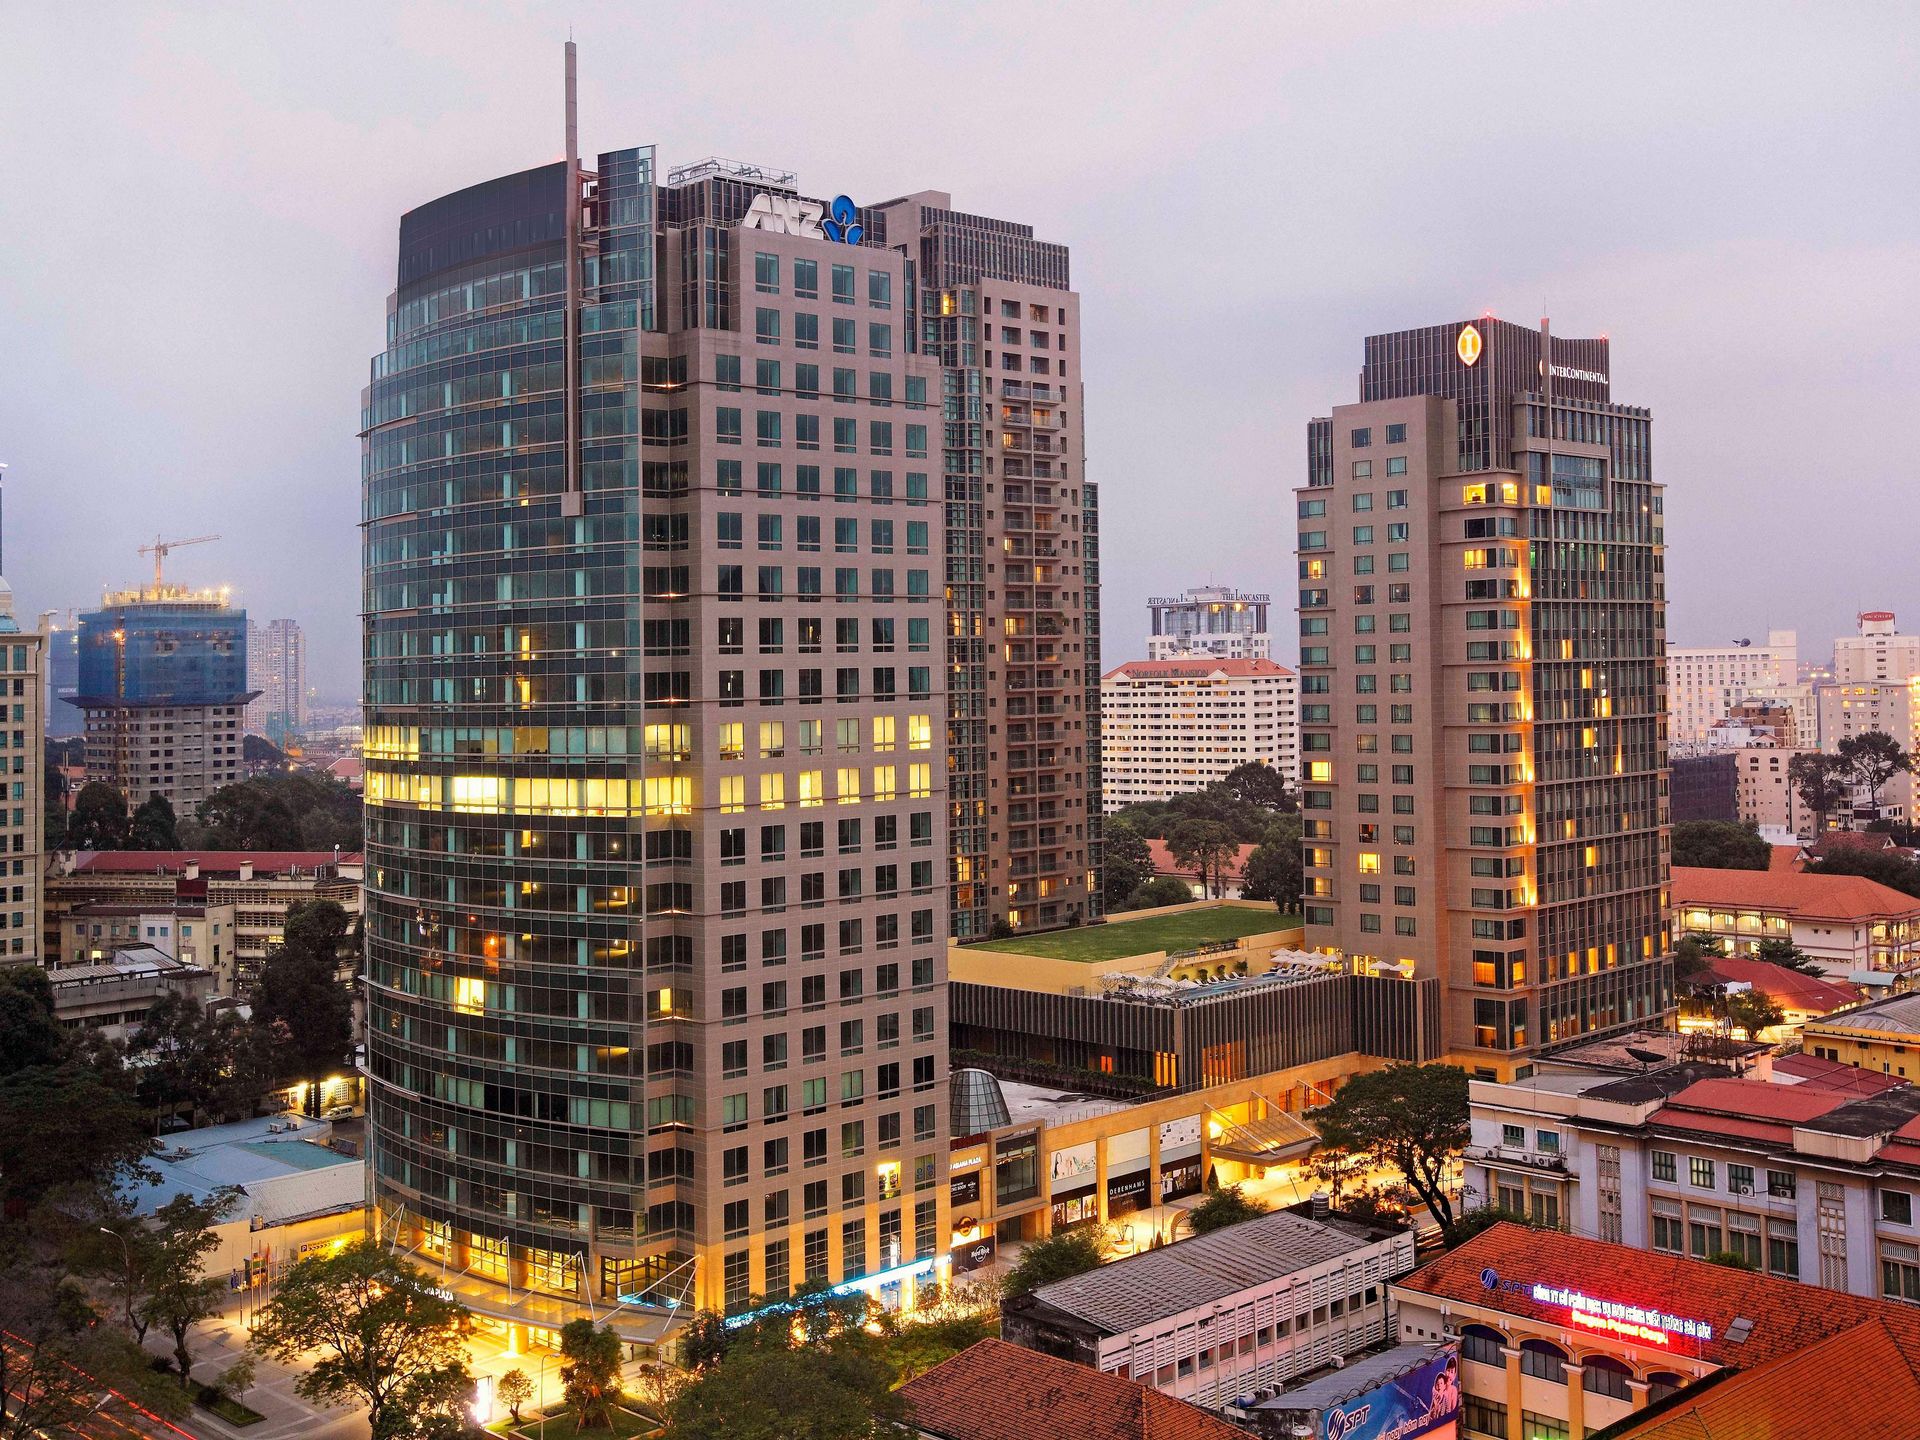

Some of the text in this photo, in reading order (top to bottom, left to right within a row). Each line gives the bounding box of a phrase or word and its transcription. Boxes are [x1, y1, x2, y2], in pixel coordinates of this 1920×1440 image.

[742, 193, 824, 240] ANZ
[1549, 364, 1608, 384] INTERCONTINENTAL
[1222, 589, 1270, 602] THE LANCASTER
[1132, 668, 1209, 678] NORFOLK MANSION
[1110, 1180, 1145, 1195] DEBENHAMS
[1503, 1280, 1531, 1294] SPT
[1344, 1404, 1371, 1432] SPT
